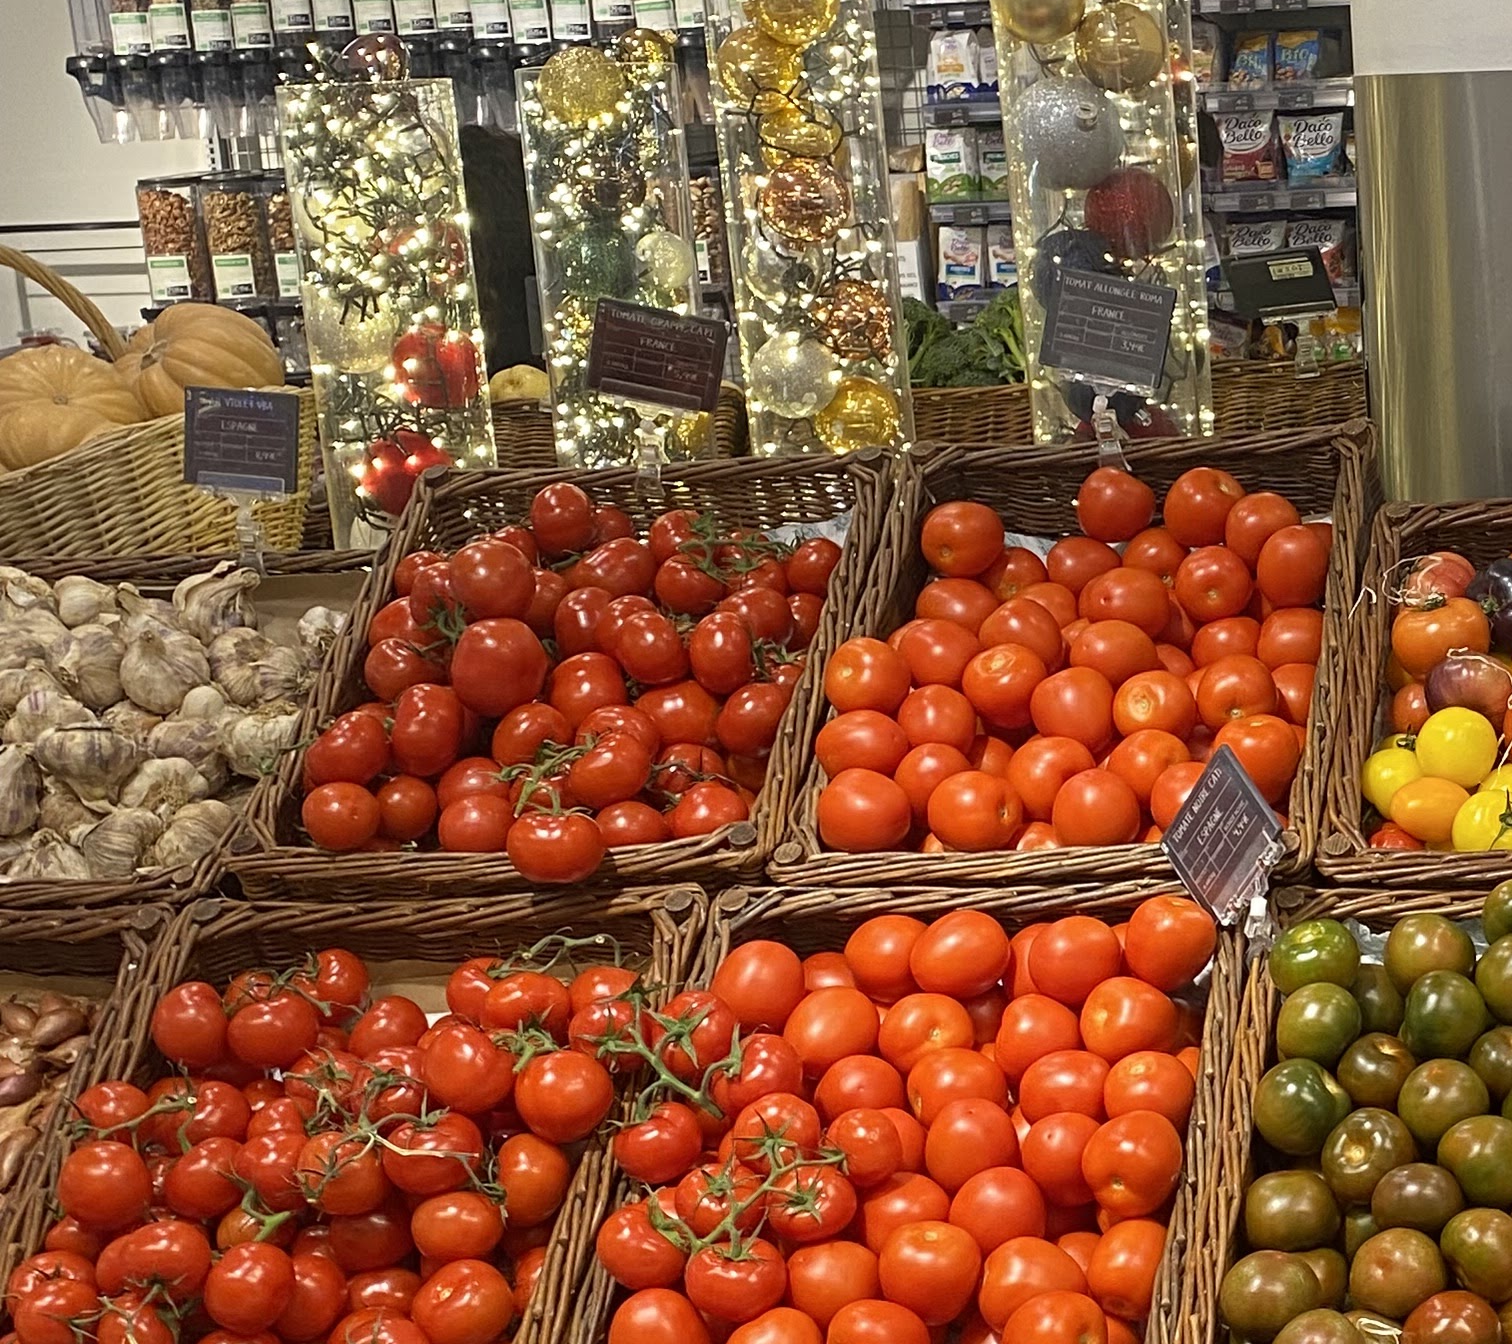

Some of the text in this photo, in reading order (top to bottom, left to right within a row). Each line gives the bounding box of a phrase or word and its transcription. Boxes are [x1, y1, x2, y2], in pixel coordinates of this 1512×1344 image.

[1224, 115, 1262, 130] Daco
[1293, 117, 1333, 133] Daco
[1223, 128, 1263, 144] Bello
[1292, 133, 1334, 148] Bello
[1295, 222, 1332, 236] Daco
[1293, 233, 1334, 246] Bello
[1139, 292, 1163, 304] ROMA
[1091, 306, 1126, 321] FRANCE
[639, 336, 676, 352] FRANCE
[1172, 812, 1194, 844] TOMATE
[1191, 787, 1211, 815] NOIRE
[1196, 806, 1224, 846] ESPAGNE
